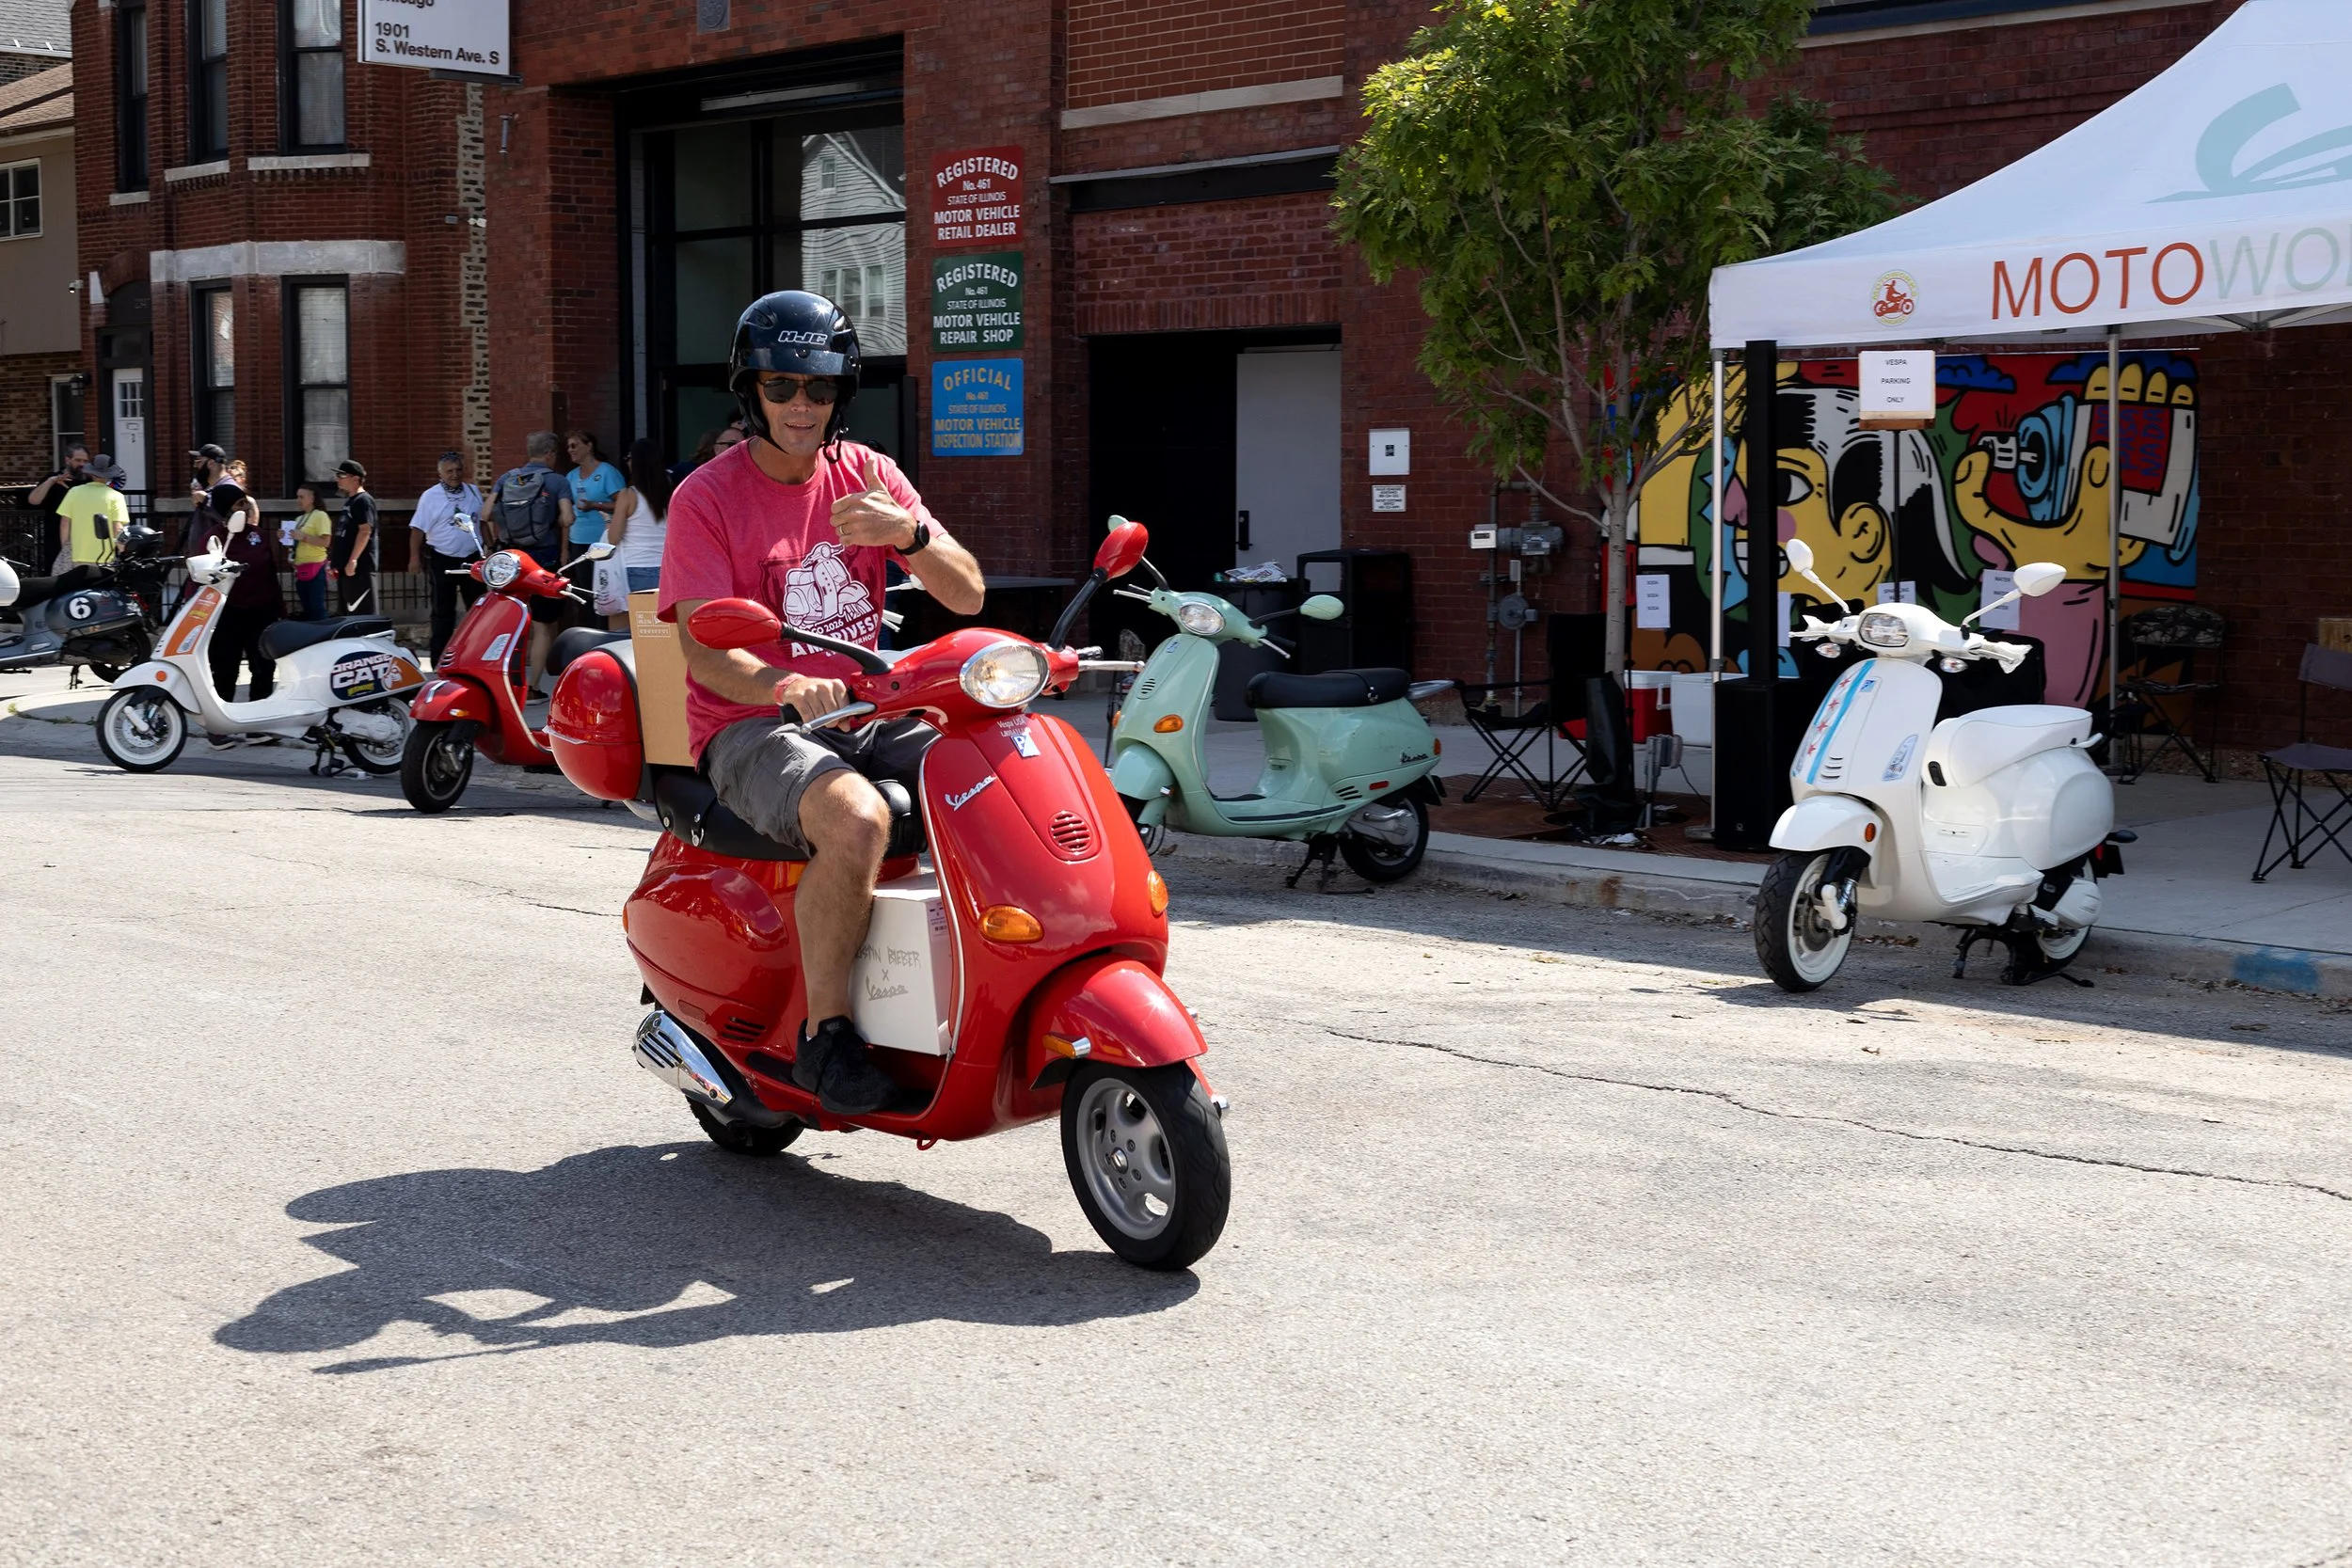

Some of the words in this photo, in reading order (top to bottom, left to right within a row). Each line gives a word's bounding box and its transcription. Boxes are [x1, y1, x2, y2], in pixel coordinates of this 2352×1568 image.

[375, 22, 409, 38] 1901
[375, 39, 390, 54] S.
[394, 40, 453, 59] Western
[455, 47, 485, 63] Ave.
[489, 51, 500, 65] S
[936, 157, 1018, 187] REGISTERED
[962, 180, 977, 191] No.
[977, 179, 991, 189] 461
[947, 195, 968, 205] STATE
[968, 194, 978, 203] OF
[978, 192, 1007, 202] ILLINOIS
[934, 209, 973, 224] MOTOR
[976, 205, 1020, 221] VEHICLE
[938, 226, 974, 240] RETAIL
[975, 222, 1016, 237] DEALER
[936, 263, 1018, 293] REGISTERED
[1992, 224, 2352, 320] MOTOWO
[946, 301, 968, 310] STATE
[968, 300, 978, 309] OF
[978, 298, 1007, 309] ILLINOIS
[933, 314, 974, 328] MOTOR
[976, 311, 1021, 326] VEHICLE
[778, 330, 828, 345] HJC
[940, 330, 977, 344] REPAIR
[982, 329, 1014, 342] SHOP
[944, 367, 1011, 391] OFFICIAL
[948, 404, 968, 414] STATE
[969, 404, 978, 414] OF
[934, 419, 974, 431] MOTOR
[977, 418, 1021, 431] VEHICLE
[934, 434, 983, 448] INSPECTION
[984, 433, 1021, 448] STATION
[2139, 409, 2166, 477] NADA
[69, 596, 91, 620] 6
[825, 620, 844, 631] 2026
[330, 654, 393, 673] ORANGE
[332, 662, 388, 689] CAT
[997, 721, 1014, 729] Vespa
[1014, 718, 1026, 726] USA
[945, 775, 997, 812] Vespa
[887, 945, 921, 969] BIEBER
[866, 975, 908, 1001] Vespa
